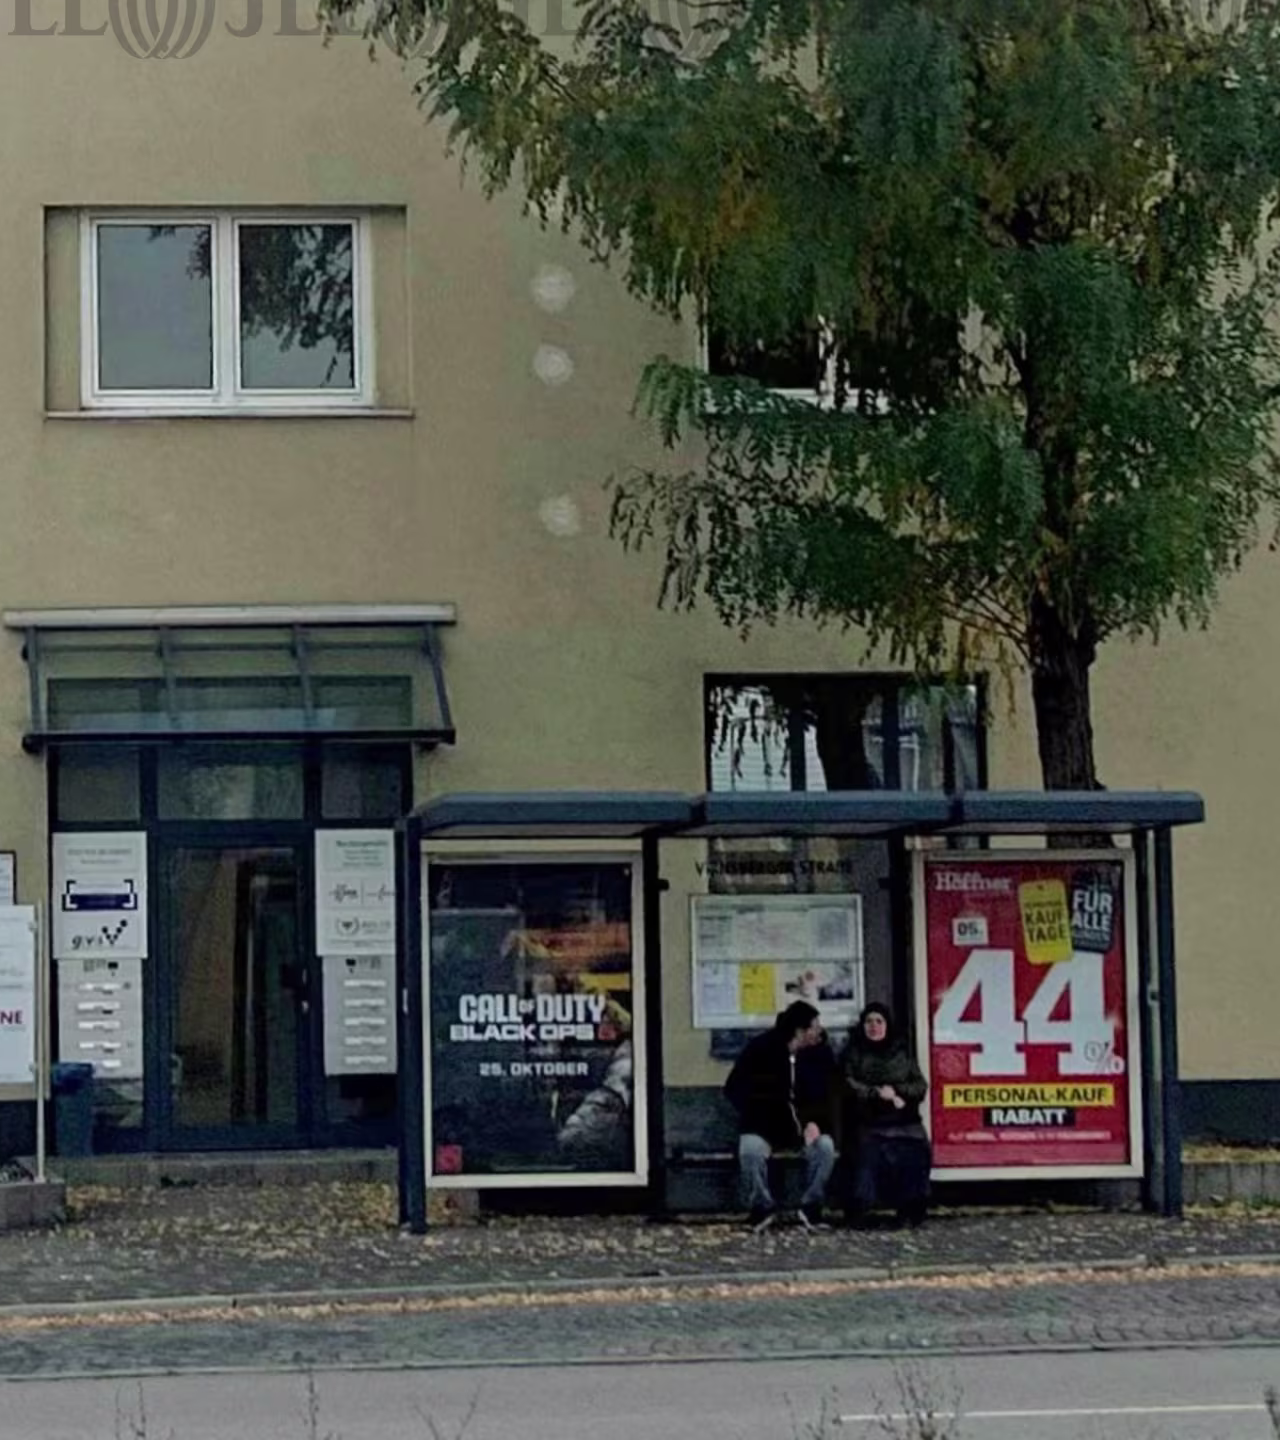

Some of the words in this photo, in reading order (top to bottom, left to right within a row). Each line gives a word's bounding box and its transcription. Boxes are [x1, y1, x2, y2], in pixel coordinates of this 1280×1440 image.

[1071, 910, 1111, 932] ALLE
[459, 994, 522, 1023] CALL
[536, 993, 606, 1023] DUTY
[449, 1024, 537, 1041] BLACK
[539, 1024, 595, 1041] OPS
[510, 1062, 589, 1076] OKTOBER
[950, 1087, 1108, 1103] PERSONAL-KAUF
[991, 1108, 1067, 1125] RABATT
